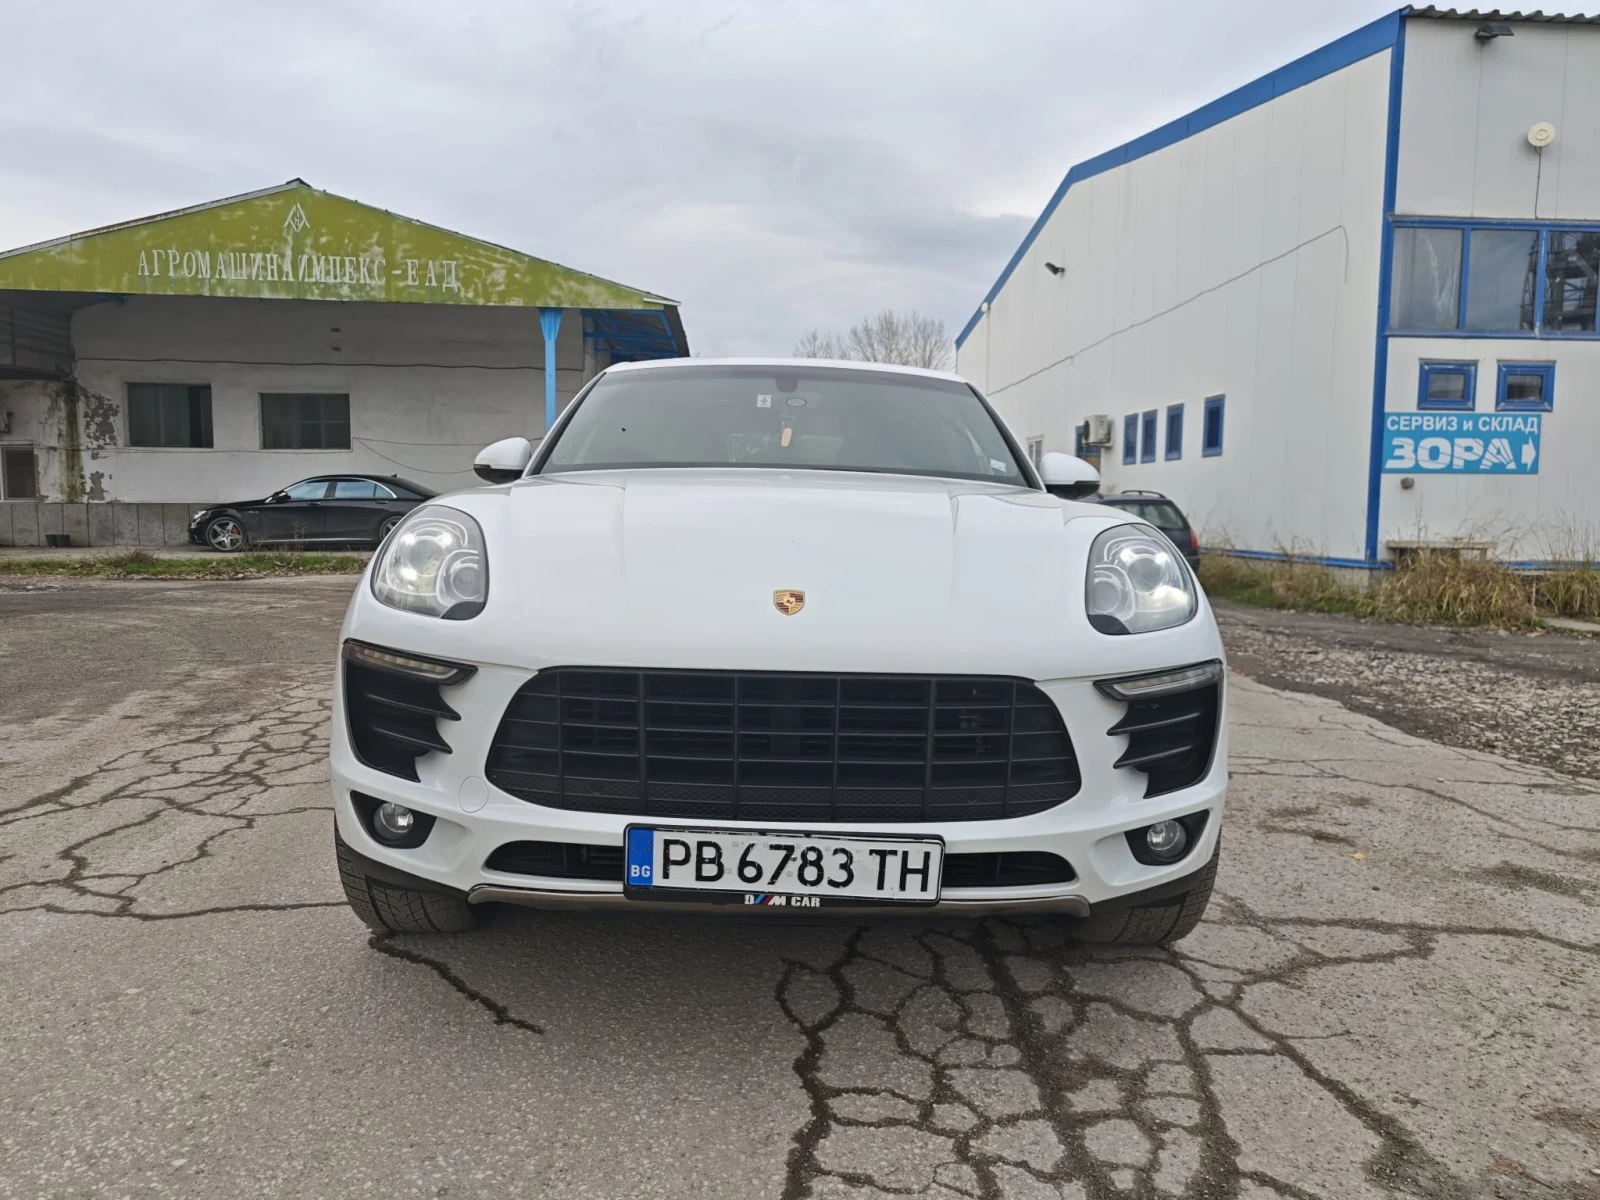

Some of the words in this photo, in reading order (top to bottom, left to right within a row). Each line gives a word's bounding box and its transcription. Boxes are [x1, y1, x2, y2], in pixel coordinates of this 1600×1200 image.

[1386, 415, 1458, 431] СЕРВИЗ
[1463, 419, 1473, 431] и
[1478, 416, 1538, 435] СКЛАД
[1384, 437, 1517, 470] ЗОРА
[630, 864, 651, 878] BG
[662, 838, 725, 882] PB
[736, 842, 855, 889] 6783
[868, 849, 932, 892] TH
[790, 896, 821, 908] CAR
